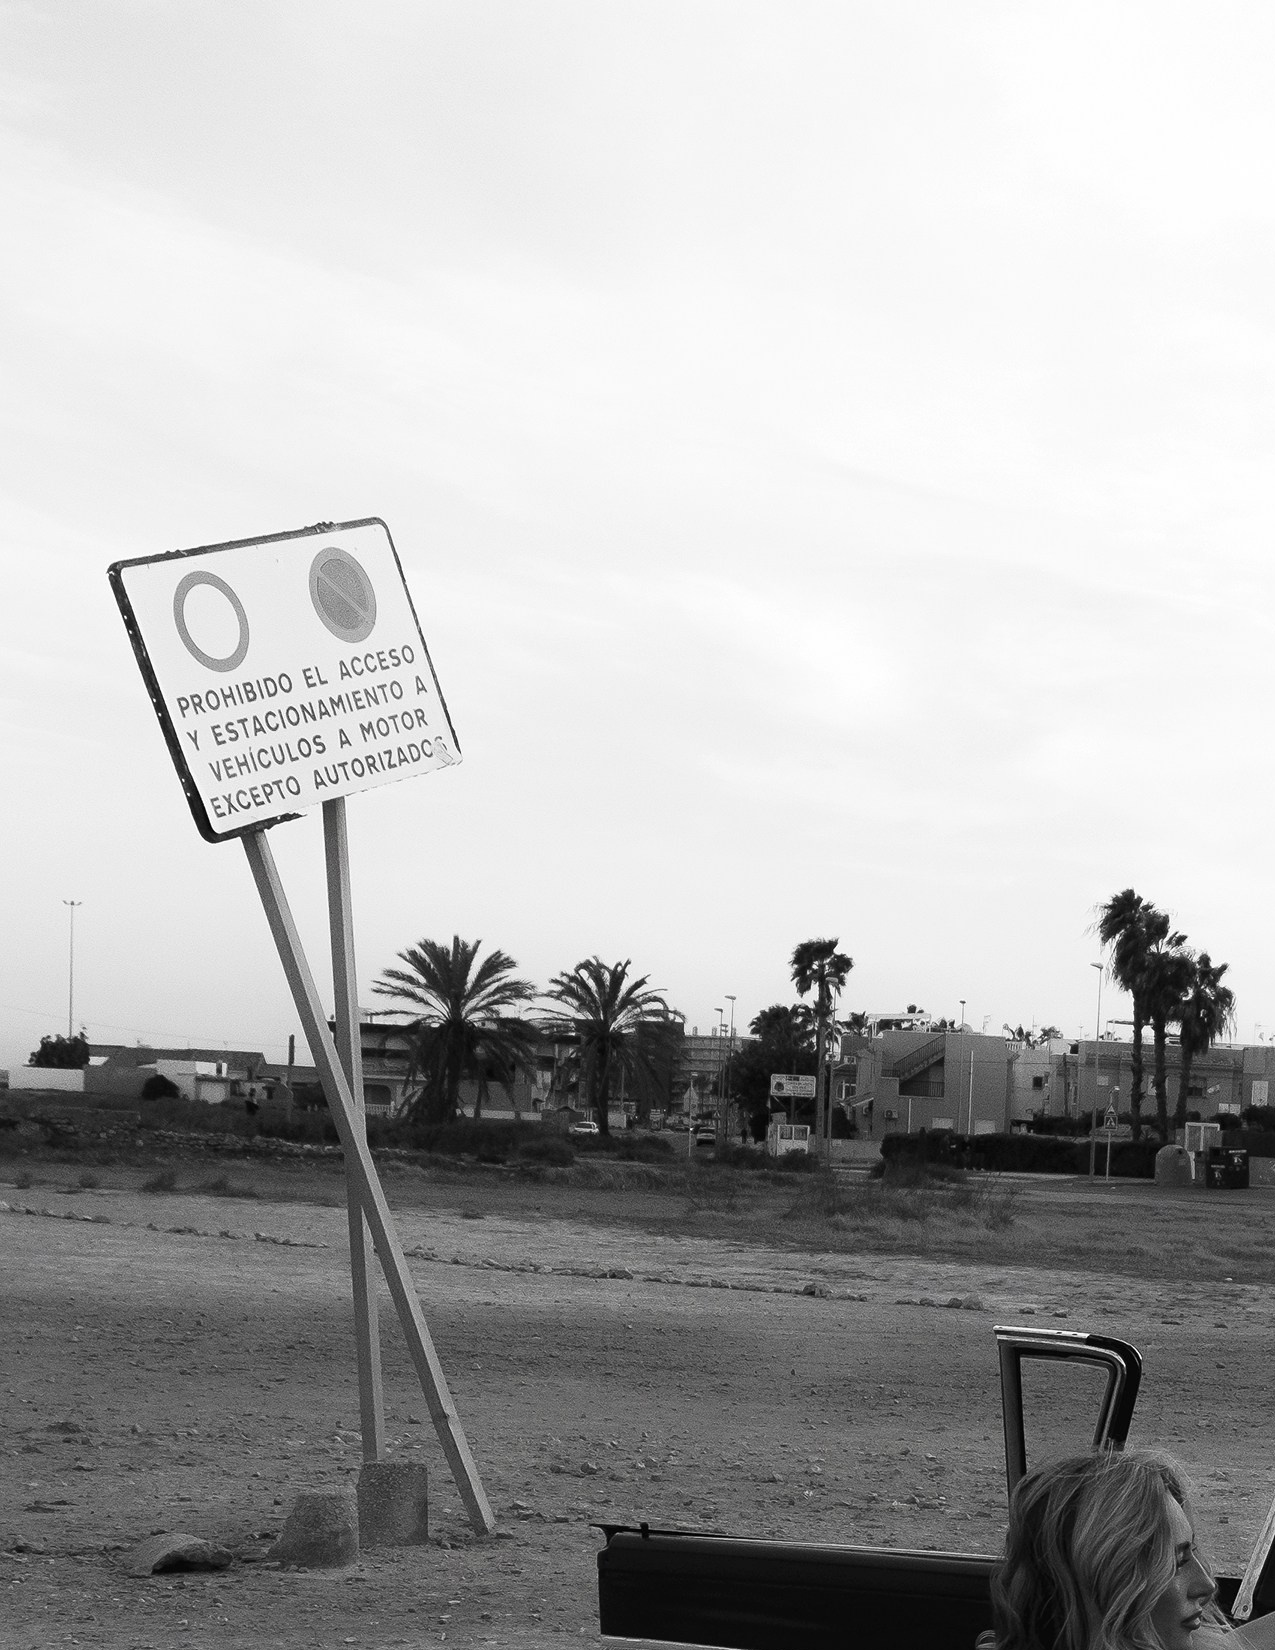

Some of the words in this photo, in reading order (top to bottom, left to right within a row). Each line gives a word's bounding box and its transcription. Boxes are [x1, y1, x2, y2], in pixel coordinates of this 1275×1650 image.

[176, 672, 293, 718] PROHIBIDO
[302, 666, 329, 689] EL
[338, 644, 416, 681] ACCESO
[186, 730, 202, 752] Y
[211, 680, 404, 747] ESTACIONAMIENTO
[415, 675, 429, 695] A
[208, 734, 326, 782] VEHÍCULOS
[339, 729, 352, 748] A
[360, 708, 429, 743] MOTOR
[210, 775, 301, 819] EXCEPTO
